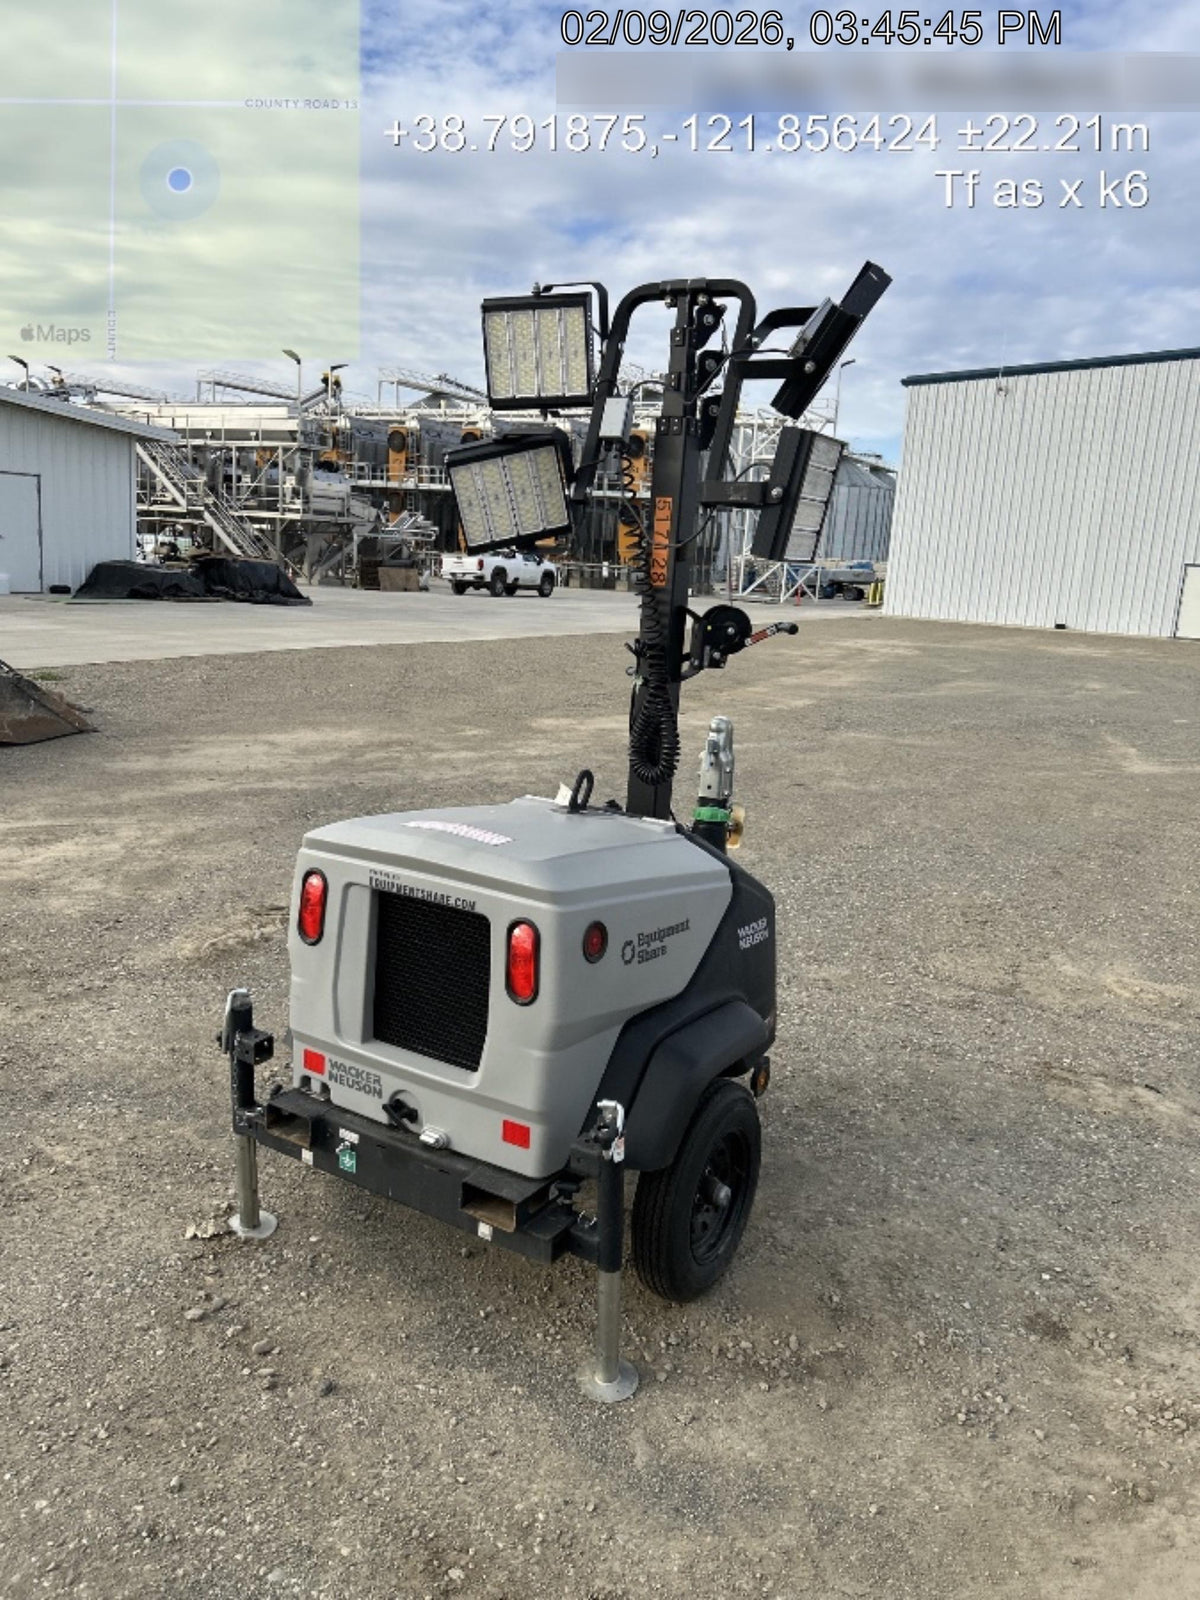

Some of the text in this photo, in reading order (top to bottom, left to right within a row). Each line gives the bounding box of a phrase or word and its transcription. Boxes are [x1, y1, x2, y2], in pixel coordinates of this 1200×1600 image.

[651, 498, 671, 584] 517128
[369, 876, 477, 911] EQUIPMENTSHARE.COM
[637, 917, 690, 948] Equipment
[637, 945, 667, 965] Share
[328, 1058, 381, 1088] WACKER
[328, 1069, 383, 1099] NEUSON
